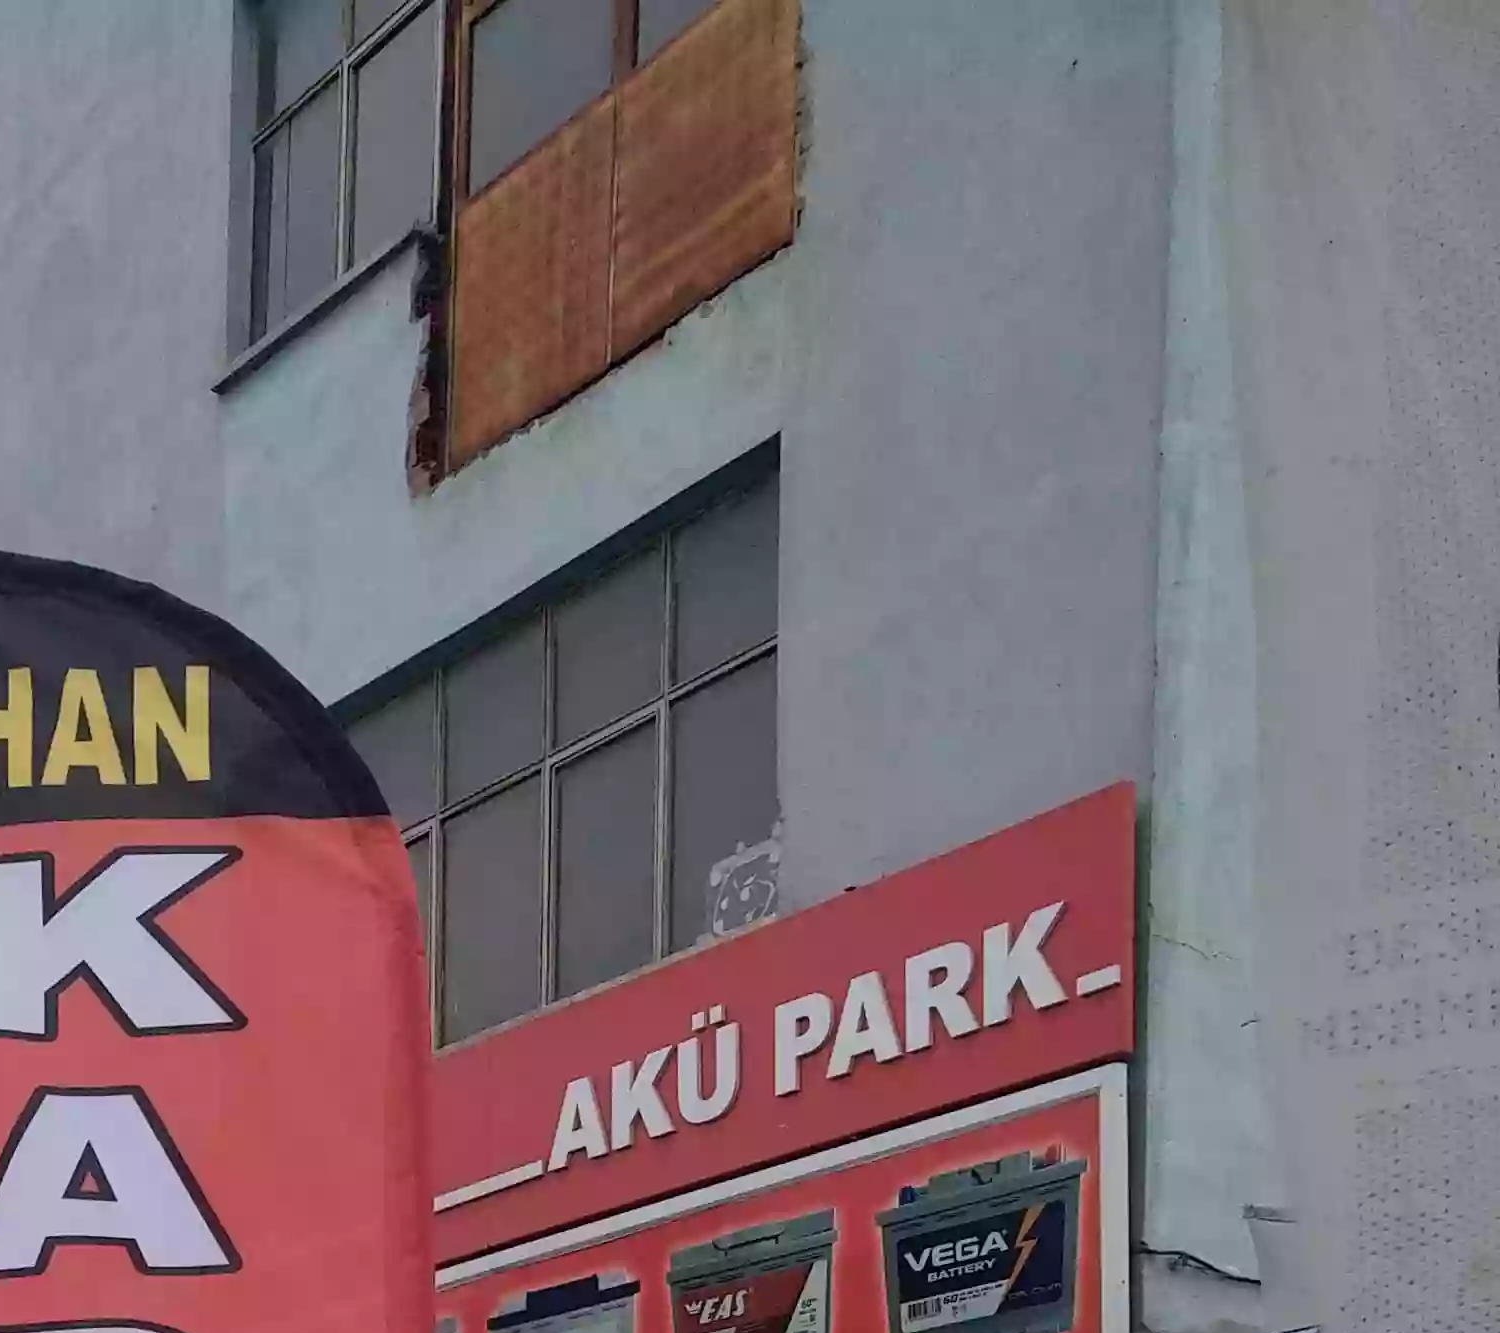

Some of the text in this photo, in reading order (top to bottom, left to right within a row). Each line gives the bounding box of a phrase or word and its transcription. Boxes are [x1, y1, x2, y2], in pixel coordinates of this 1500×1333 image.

[547, 900, 1074, 1173] AKÜ PARK
[904, 1231, 1009, 1272] VEGA
[927, 1258, 997, 1283] BATTERY
[700, 1289, 749, 1325] EAS
